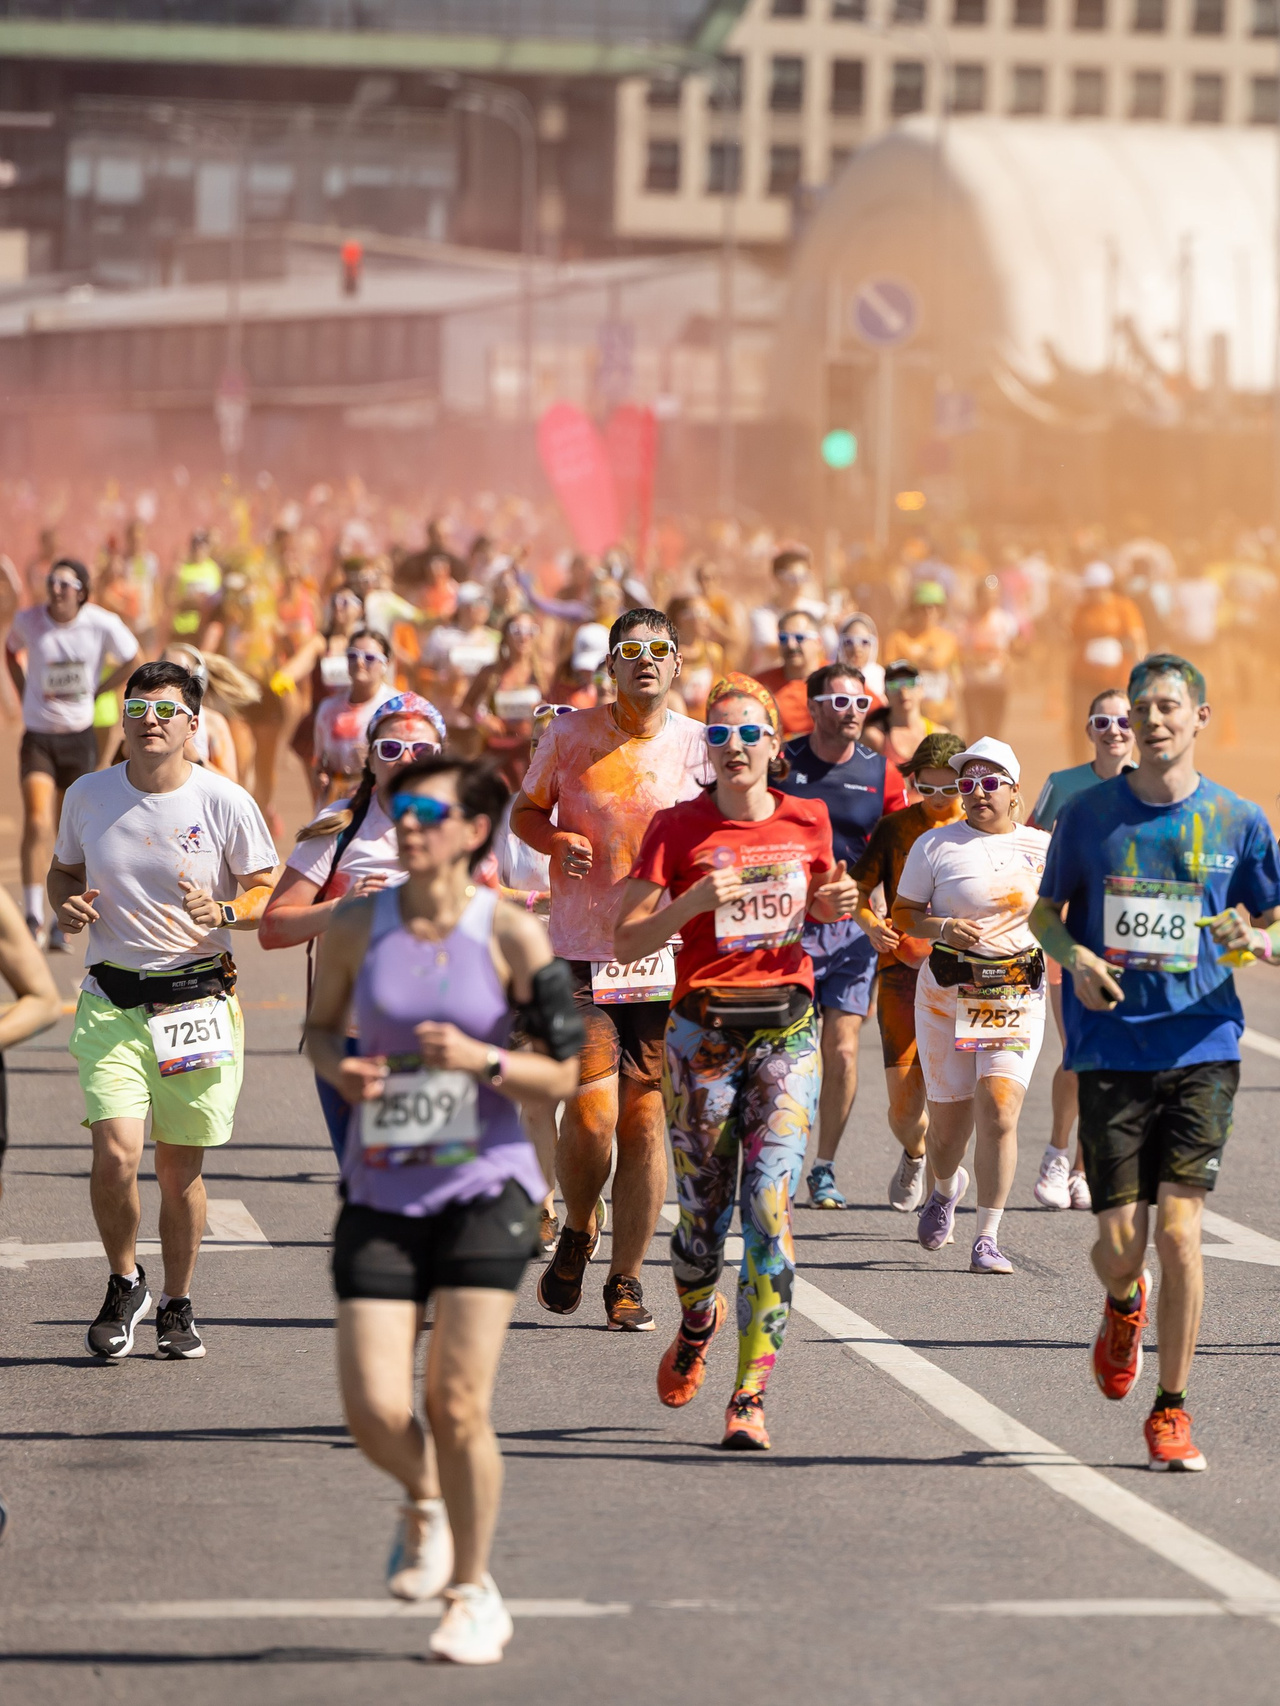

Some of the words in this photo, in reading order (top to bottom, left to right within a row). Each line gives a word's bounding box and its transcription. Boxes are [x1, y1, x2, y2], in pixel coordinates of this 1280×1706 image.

[731, 893, 792, 922] 3150
[1116, 910, 1186, 940] 6848
[606, 957, 660, 978] 6747
[164, 1017, 221, 1048] 7251
[967, 1008, 1020, 1029] 7252
[375, 1090, 456, 1128] 2509
